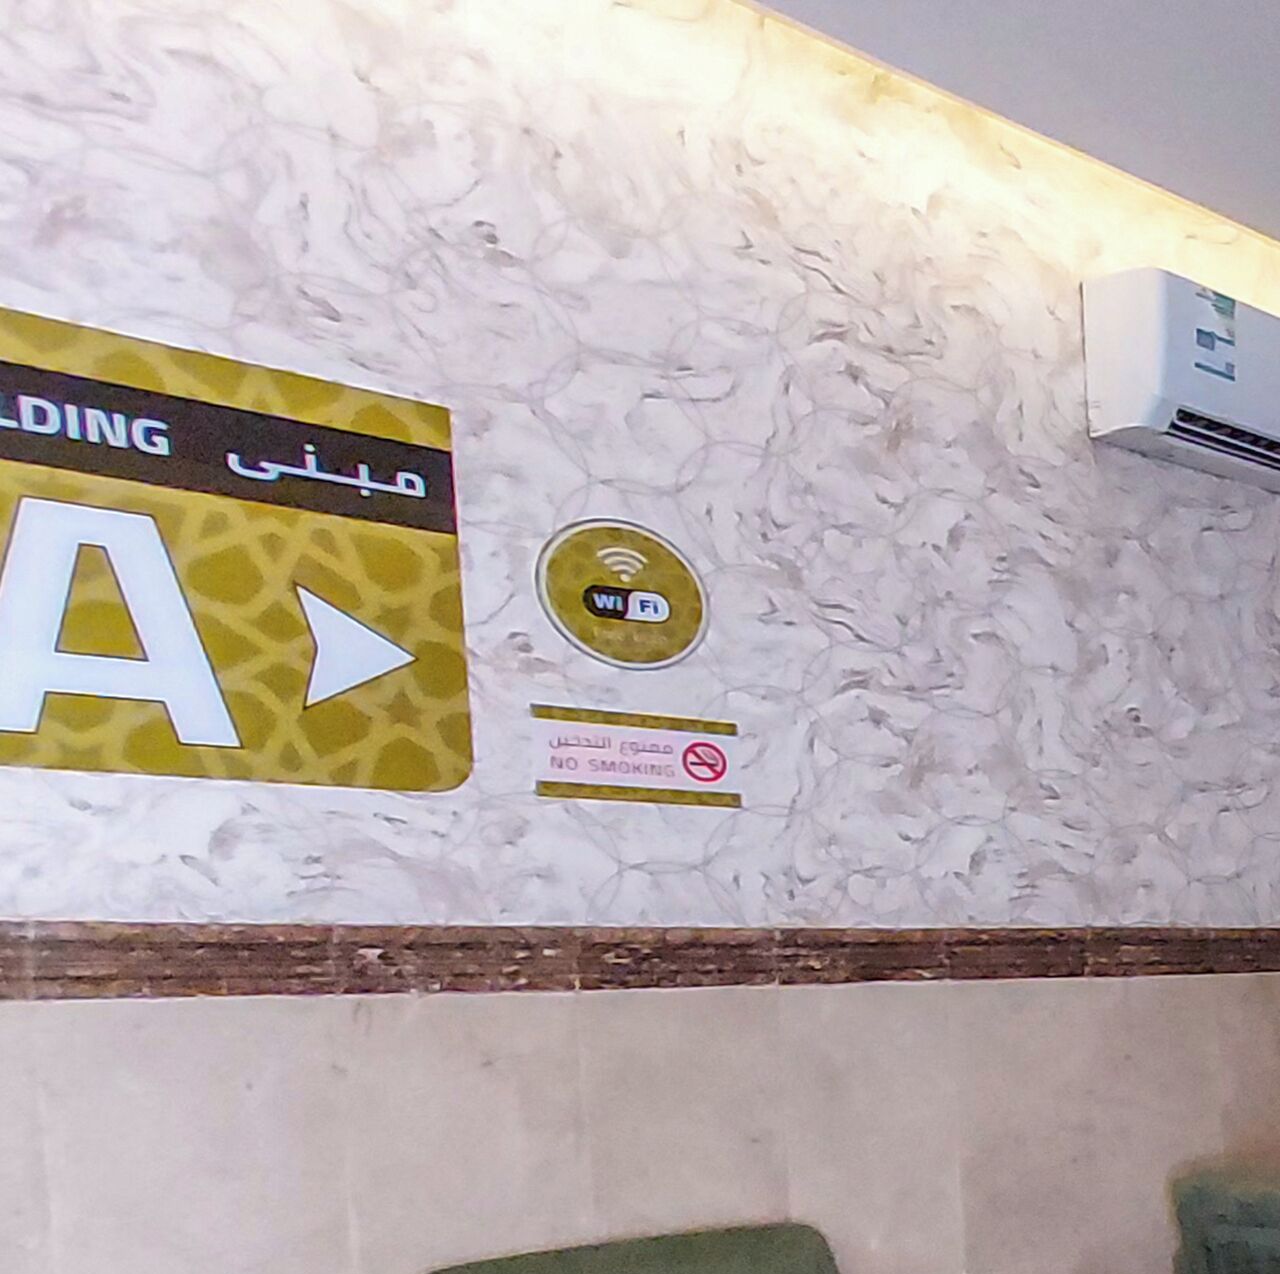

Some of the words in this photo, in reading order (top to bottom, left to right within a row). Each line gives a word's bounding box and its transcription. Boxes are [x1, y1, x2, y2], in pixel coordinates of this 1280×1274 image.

[226, 443, 426, 498] مبنى
[0, 496, 243, 748] A
[550, 756, 579, 771] NO
[588, 759, 676, 777] SMOKING
